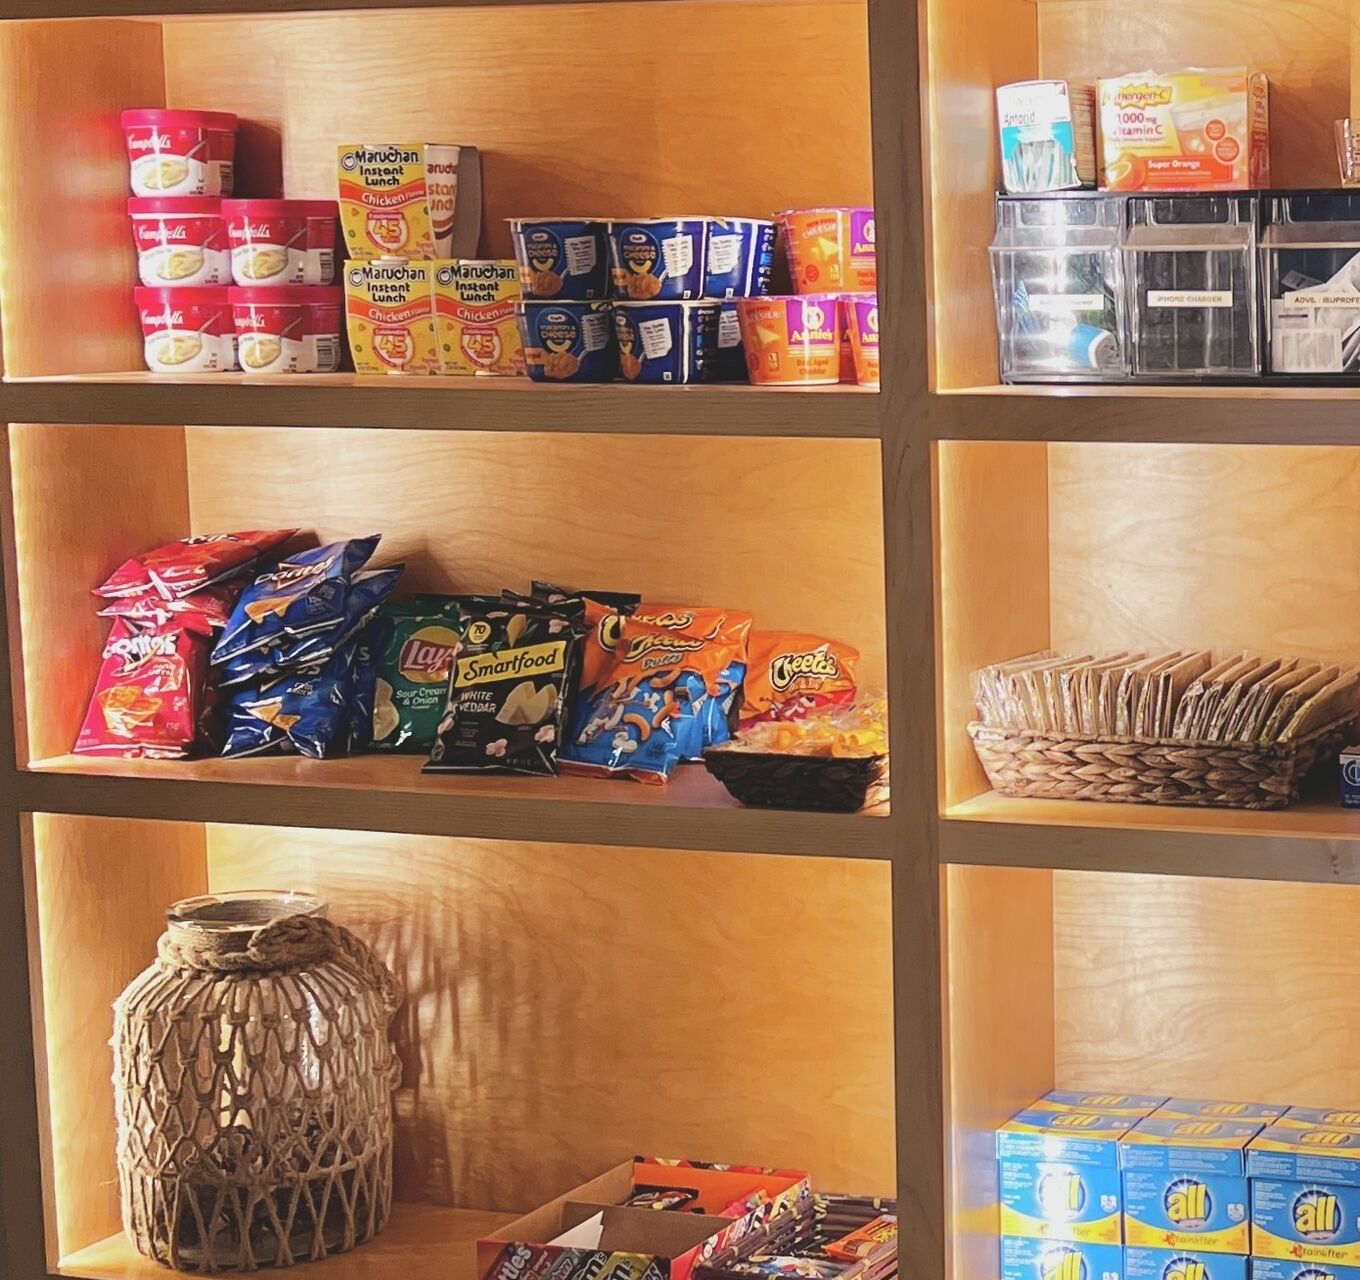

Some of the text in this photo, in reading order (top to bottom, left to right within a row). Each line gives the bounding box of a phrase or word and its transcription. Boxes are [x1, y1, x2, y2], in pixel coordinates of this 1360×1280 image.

[1113, 90, 1169, 104] mergen-C
[1117, 112, 1145, 124] 1000
[1115, 124, 1164, 136] itamin C
[355, 147, 419, 163] Maruchan
[1148, 159, 1201, 169] Super Orange
[360, 166, 404, 176] Instant
[365, 176, 400, 186] Lunch
[362, 192, 406, 206] Chicken
[362, 266, 426, 281] Maruchan
[451, 265, 515, 280] Maruchan
[367, 282, 411, 293] Instant
[455, 280, 500, 292] Instant
[372, 294, 406, 303] Lunch
[460, 292, 495, 302] Lunch
[1294, 296, 1316, 305] ADVIL
[368, 307, 411, 322] Chicken
[456, 307, 500, 321] Chicken
[474, 624, 487, 635] 70
[463, 648, 559, 681] Smartfood
[772, 649, 838, 690] Cheetos
[396, 689, 418, 699] Sour
[461, 691, 494, 701] WHITE
[411, 696, 439, 705] Onion
[1167, 1183, 1207, 1221] all
[1295, 1195, 1336, 1232] all
